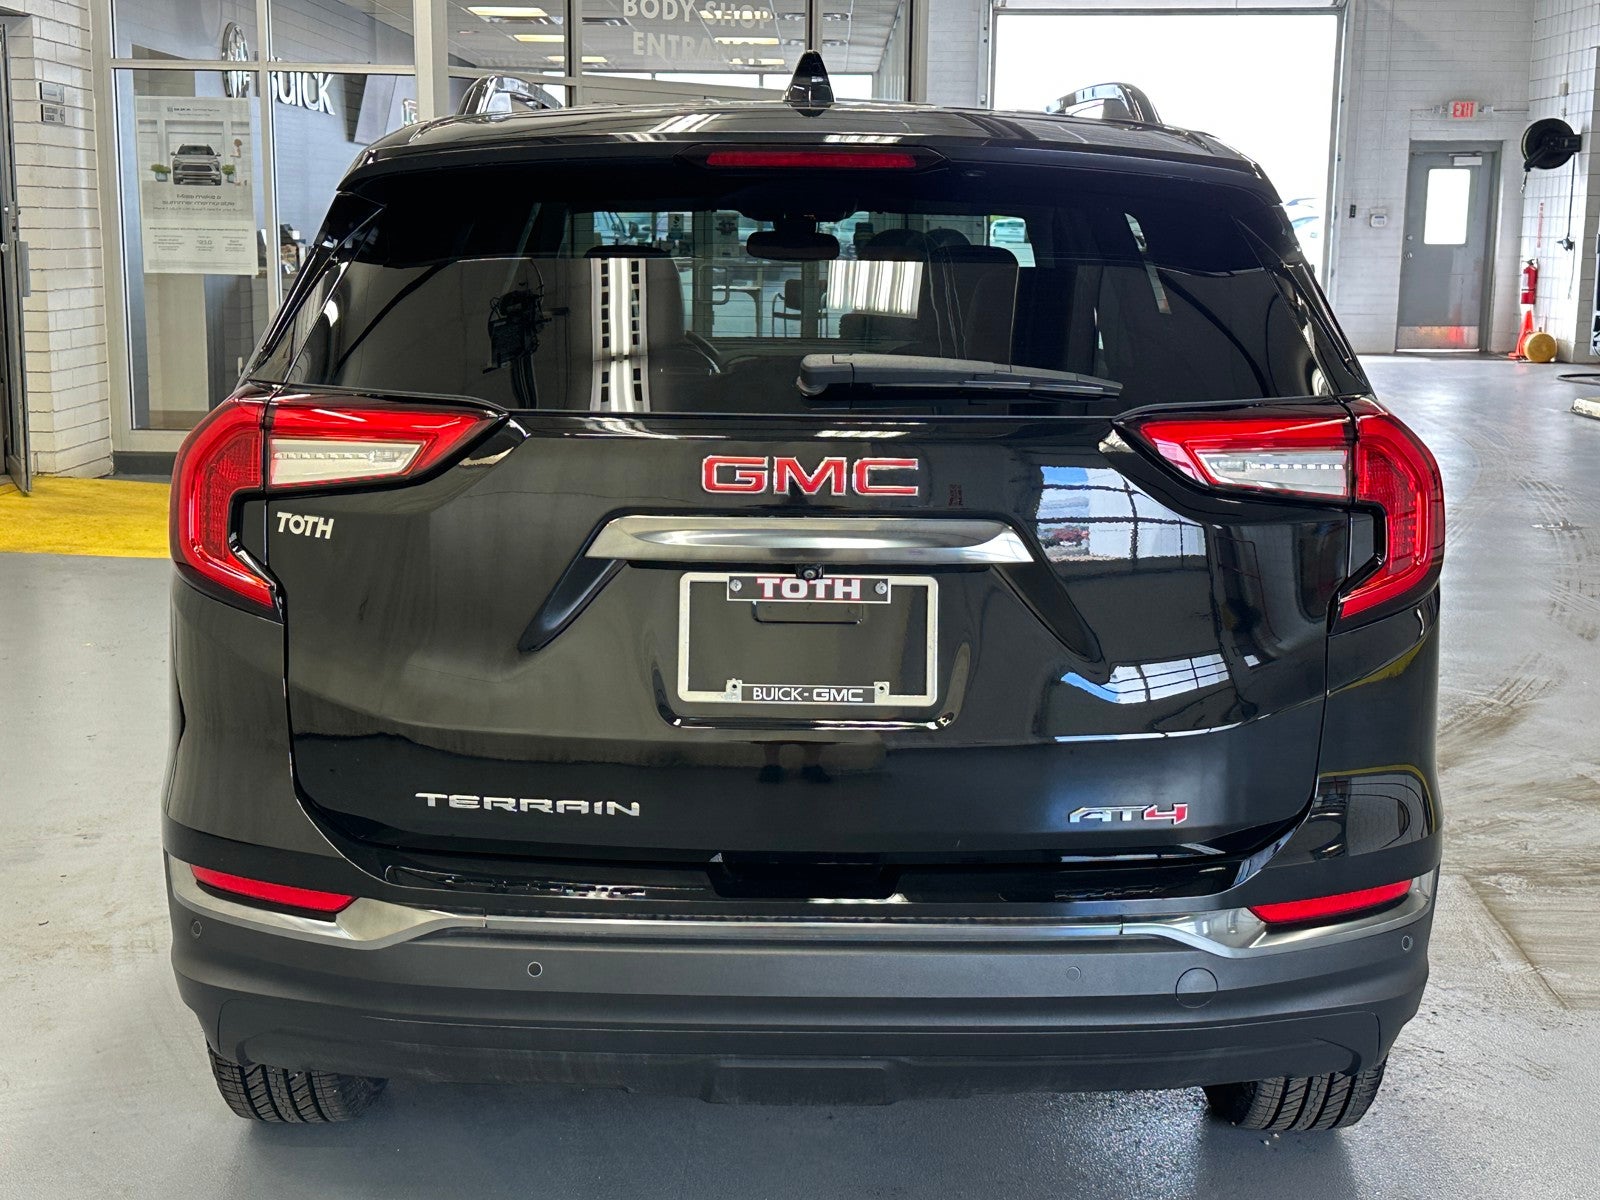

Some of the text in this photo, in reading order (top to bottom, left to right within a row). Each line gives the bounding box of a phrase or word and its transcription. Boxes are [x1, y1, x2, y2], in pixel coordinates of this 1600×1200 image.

[623, 0, 772, 29] BODY SHOP
[1453, 101, 1474, 118] EXIT
[701, 455, 919, 497] GMC
[276, 511, 335, 540] TOTH
[757, 577, 861, 600] TOTH
[415, 792, 640, 817] TERRAIN
[1068, 803, 1189, 825] AT4
